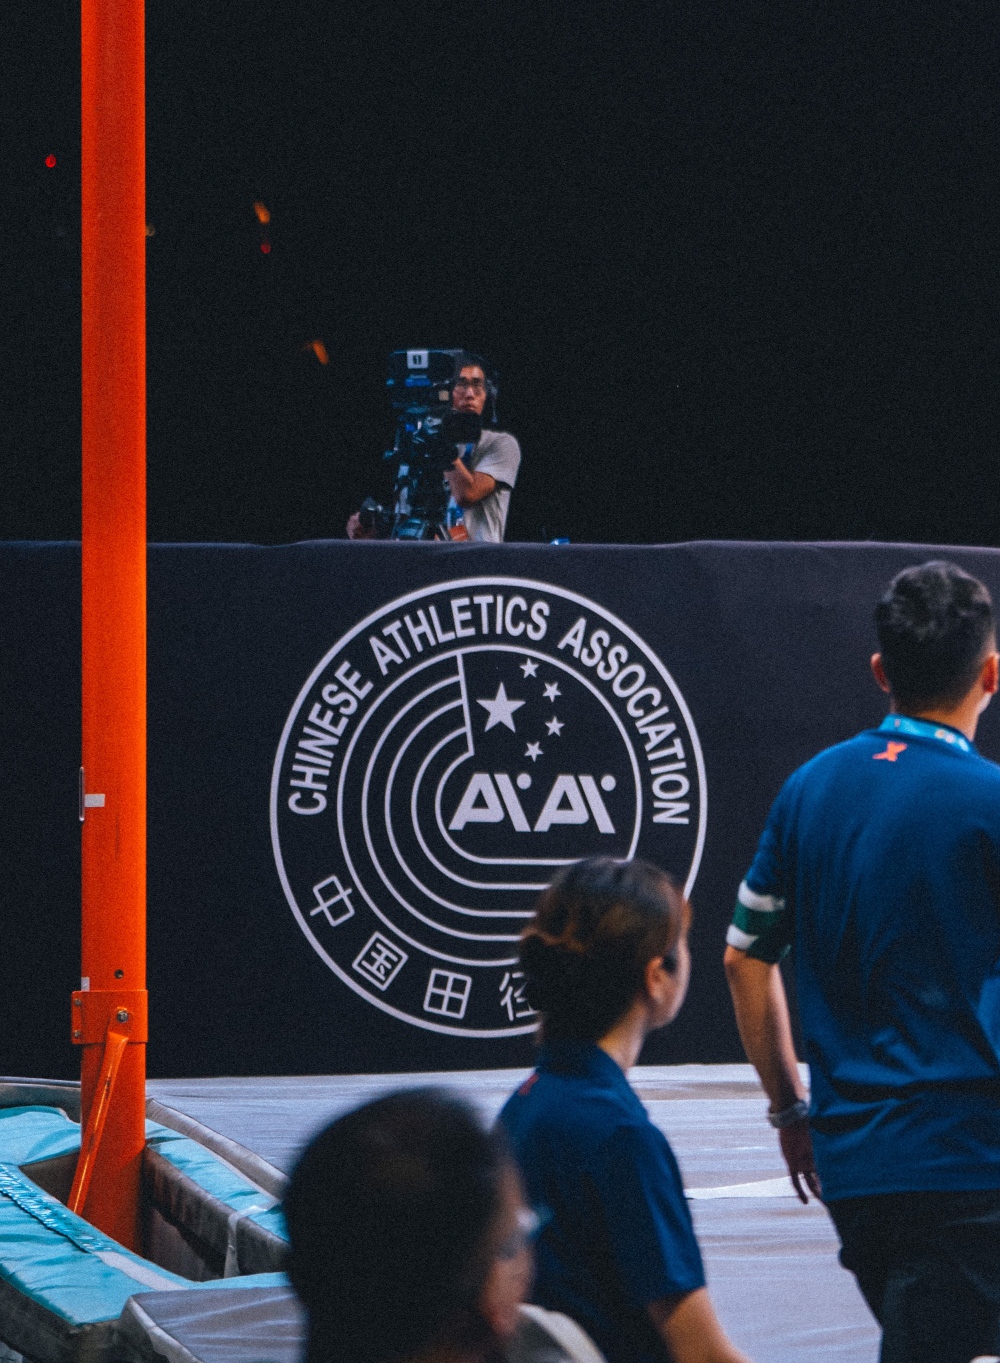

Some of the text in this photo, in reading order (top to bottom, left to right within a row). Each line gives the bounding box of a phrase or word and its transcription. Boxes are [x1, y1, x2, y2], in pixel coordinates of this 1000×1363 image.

[288, 595, 690, 825] CHINESE ATHLETICS ASSOCIATION
